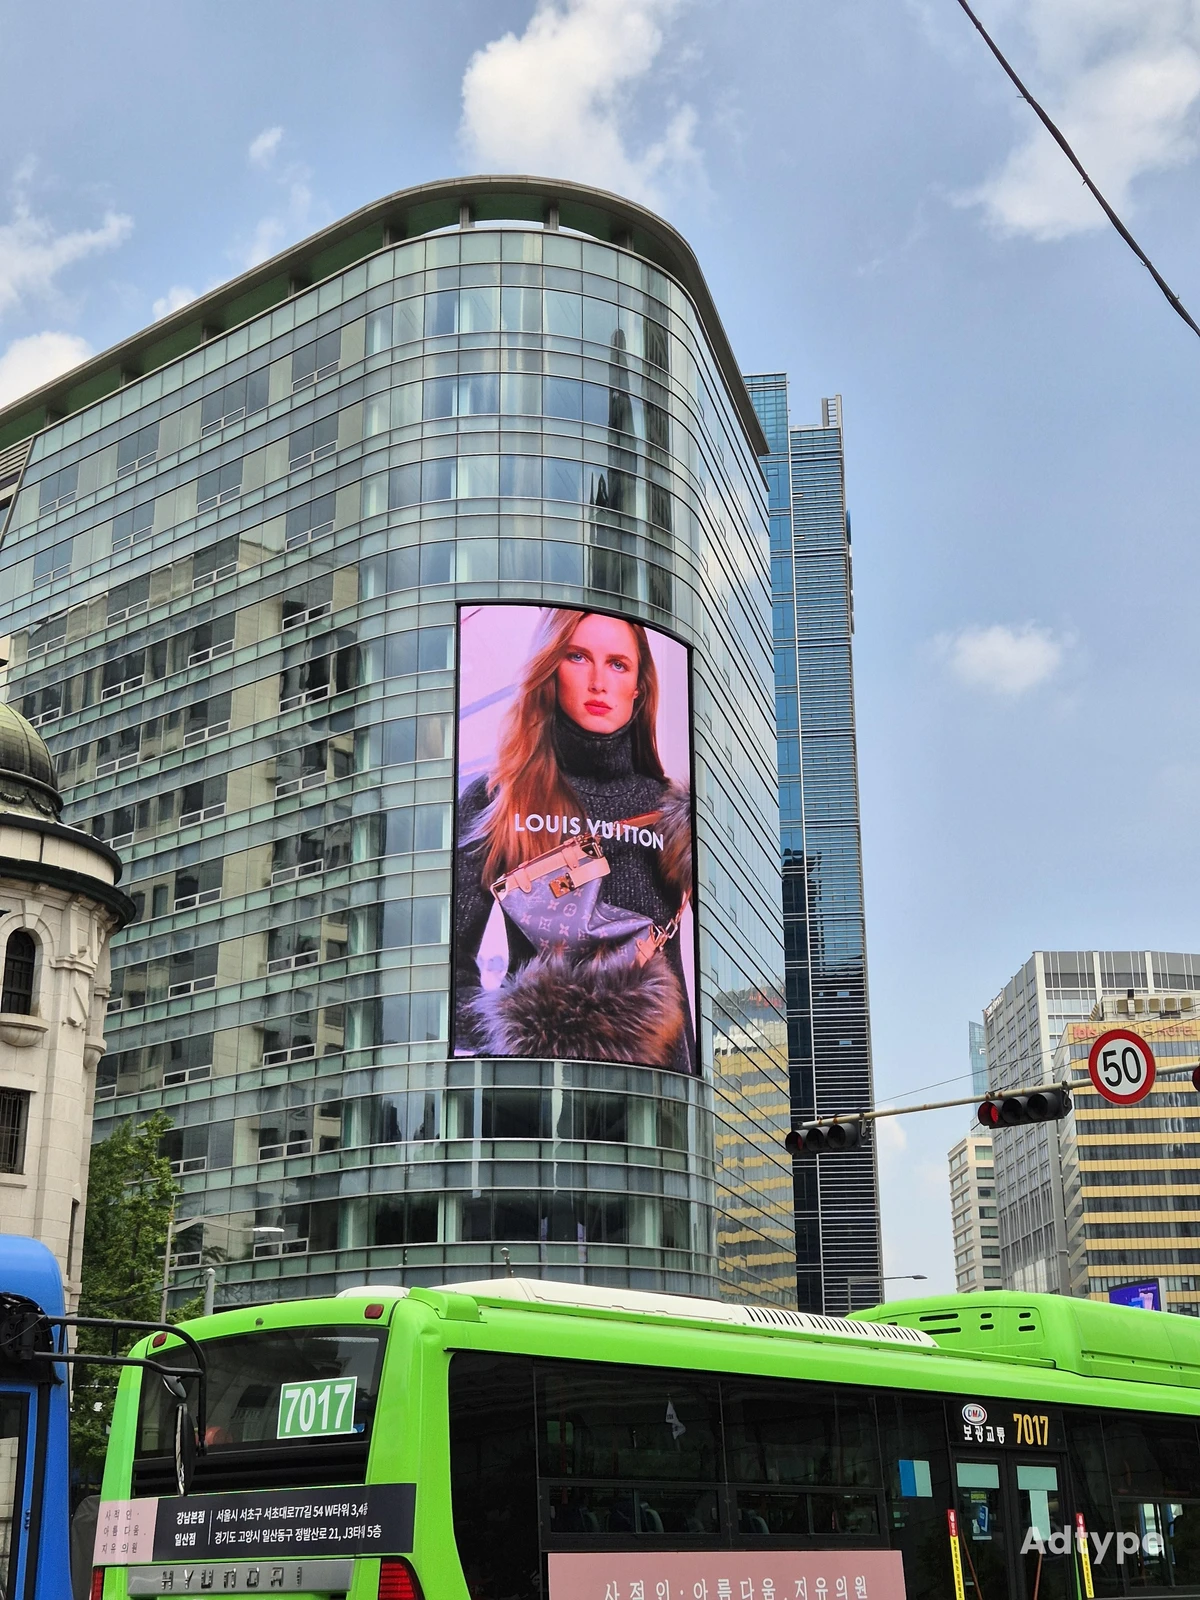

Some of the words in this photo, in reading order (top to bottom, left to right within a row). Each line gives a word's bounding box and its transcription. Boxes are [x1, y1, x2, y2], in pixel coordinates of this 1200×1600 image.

[514, 813, 581, 835] LOUIS
[586, 818, 664, 851] VUITTON
[1073, 1025, 1097, 1039] ibis
[1102, 1046, 1142, 1087] 50
[284, 1383, 352, 1433] 7017
[963, 1424, 1005, 1444] 보광교통
[1013, 1413, 1049, 1446] 7017
[176, 1510, 206, 1525] 강남본점
[216, 1508, 239, 1523] 서울시
[239, 1507, 263, 1521] 서초구
[263, 1505, 313, 1520] 서초대로77길
[312, 1505, 324, 1518] 54
[324, 1503, 350, 1517] W타워
[174, 1532, 197, 1547] 일산점
[214, 1531, 237, 1545] 경기도
[237, 1529, 261, 1544] 고양시
[262, 1528, 294, 1543] 일산동구
[294, 1526, 328, 1542] 정발산로
[328, 1527, 342, 1542] 21,
[366, 1523, 383, 1539] 5층
[161, 1567, 303, 1590] HYUNDAI
